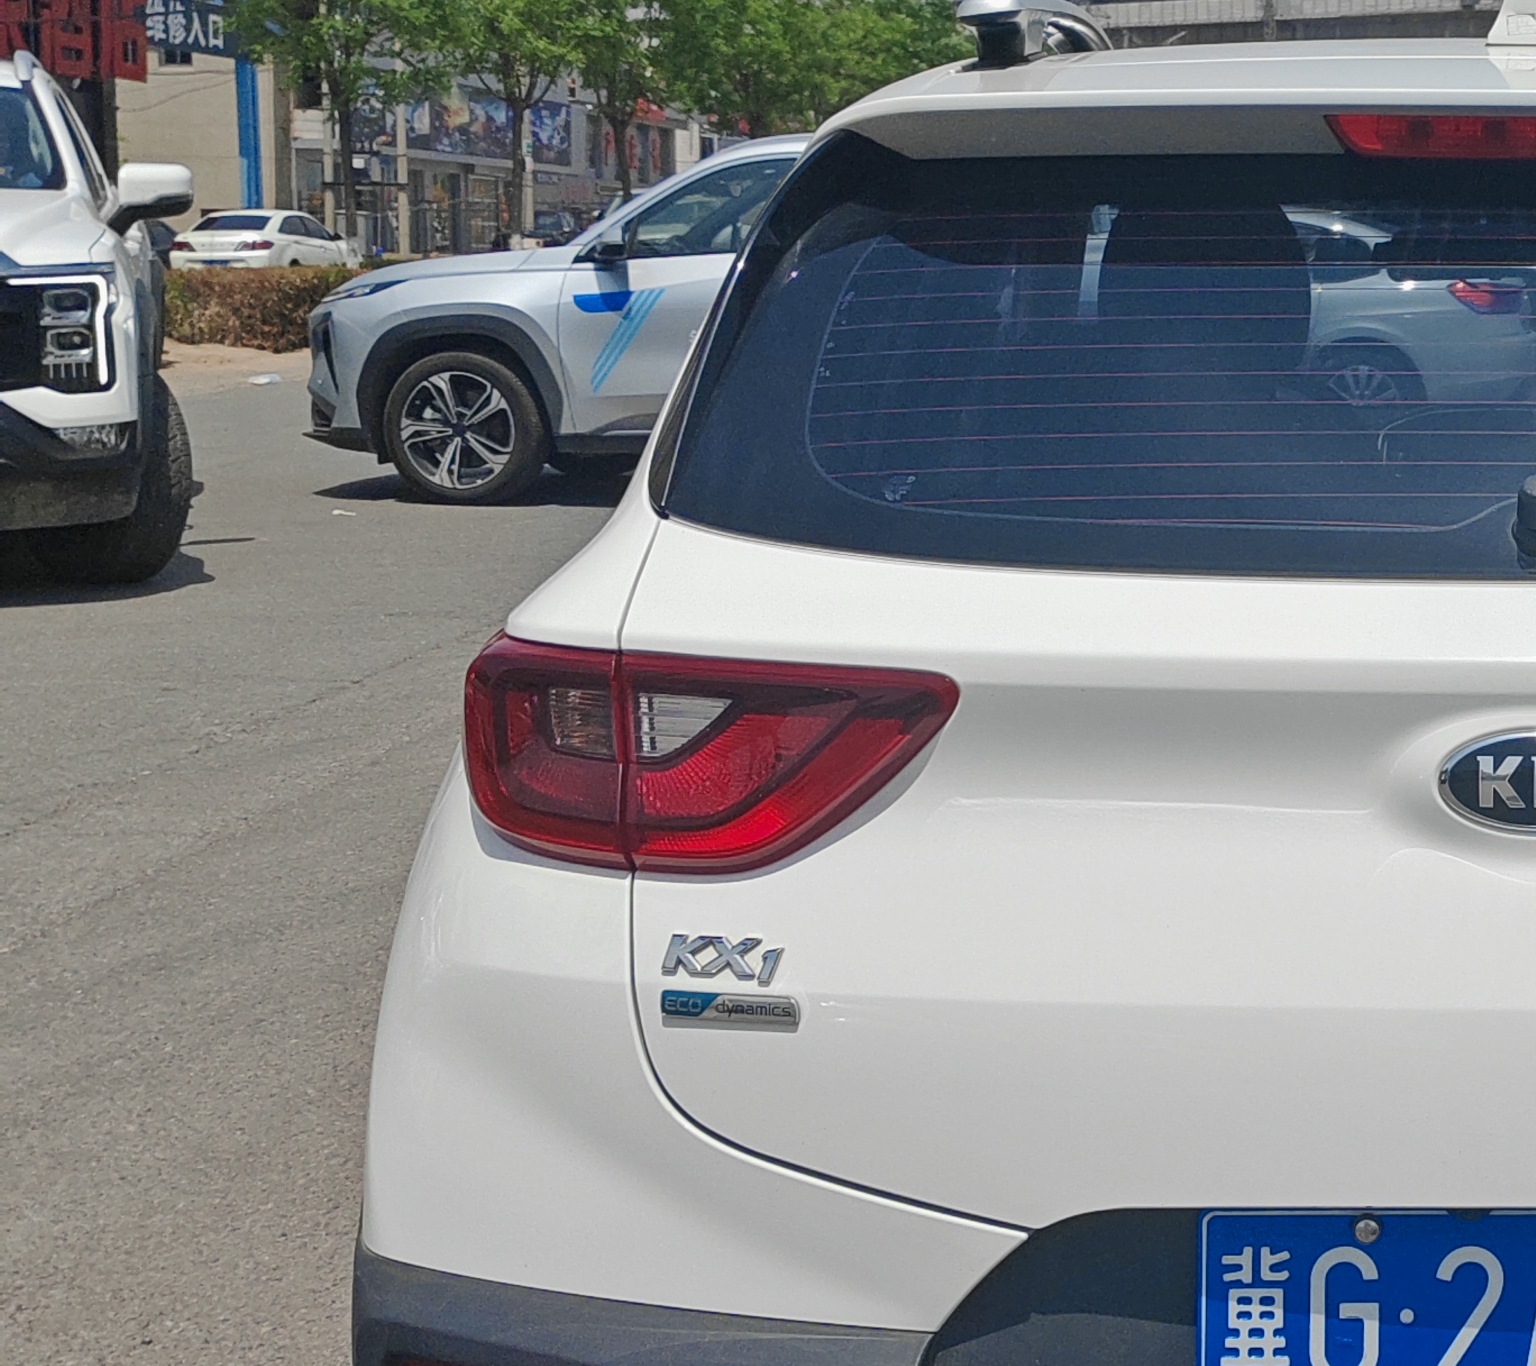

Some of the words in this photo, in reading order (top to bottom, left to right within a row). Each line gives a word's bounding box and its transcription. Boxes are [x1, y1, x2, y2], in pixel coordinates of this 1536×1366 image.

[661, 933, 785, 987] KX1
[664, 996, 702, 1012] ECO
[715, 999, 792, 1017] dynamics
